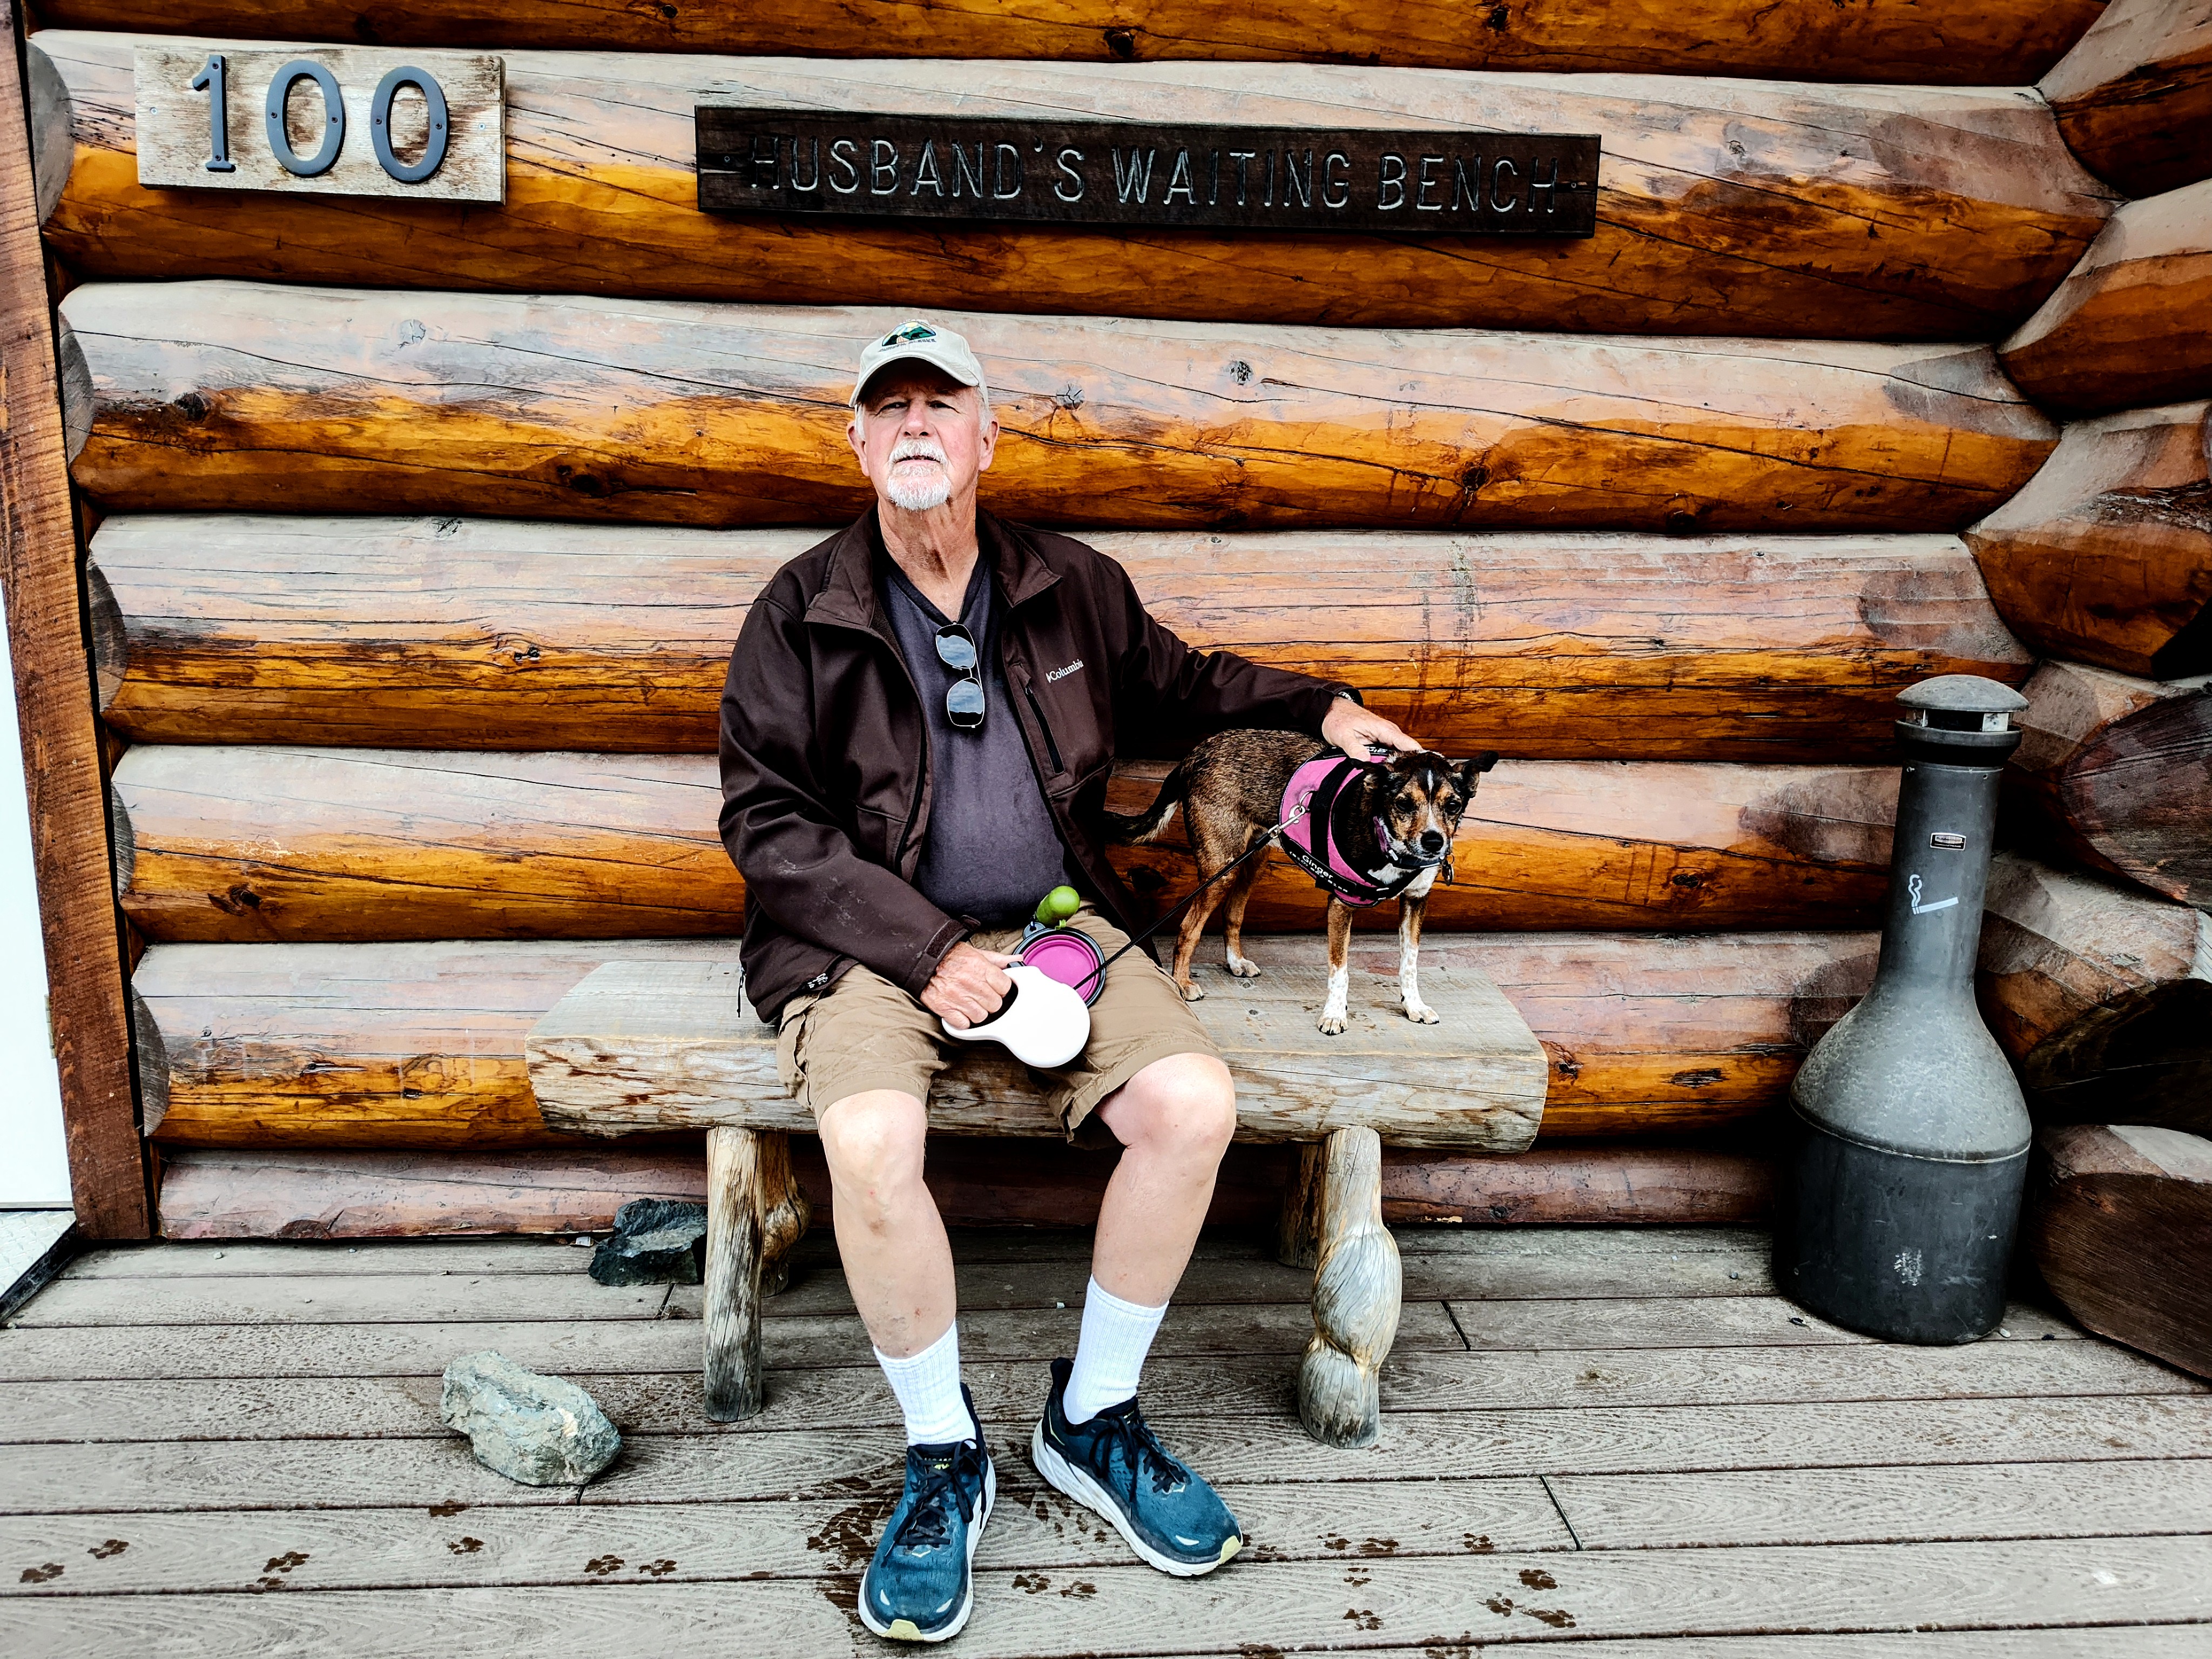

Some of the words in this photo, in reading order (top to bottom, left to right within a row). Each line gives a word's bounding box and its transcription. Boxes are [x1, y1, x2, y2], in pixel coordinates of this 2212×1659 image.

[192, 55, 450, 184] 100
[748, 135, 1085, 203] HUSBAND'S
[1110, 144, 1350, 208] WAITING
[1377, 151, 1558, 213] BENCH
[1302, 855, 1333, 879] Ginger
